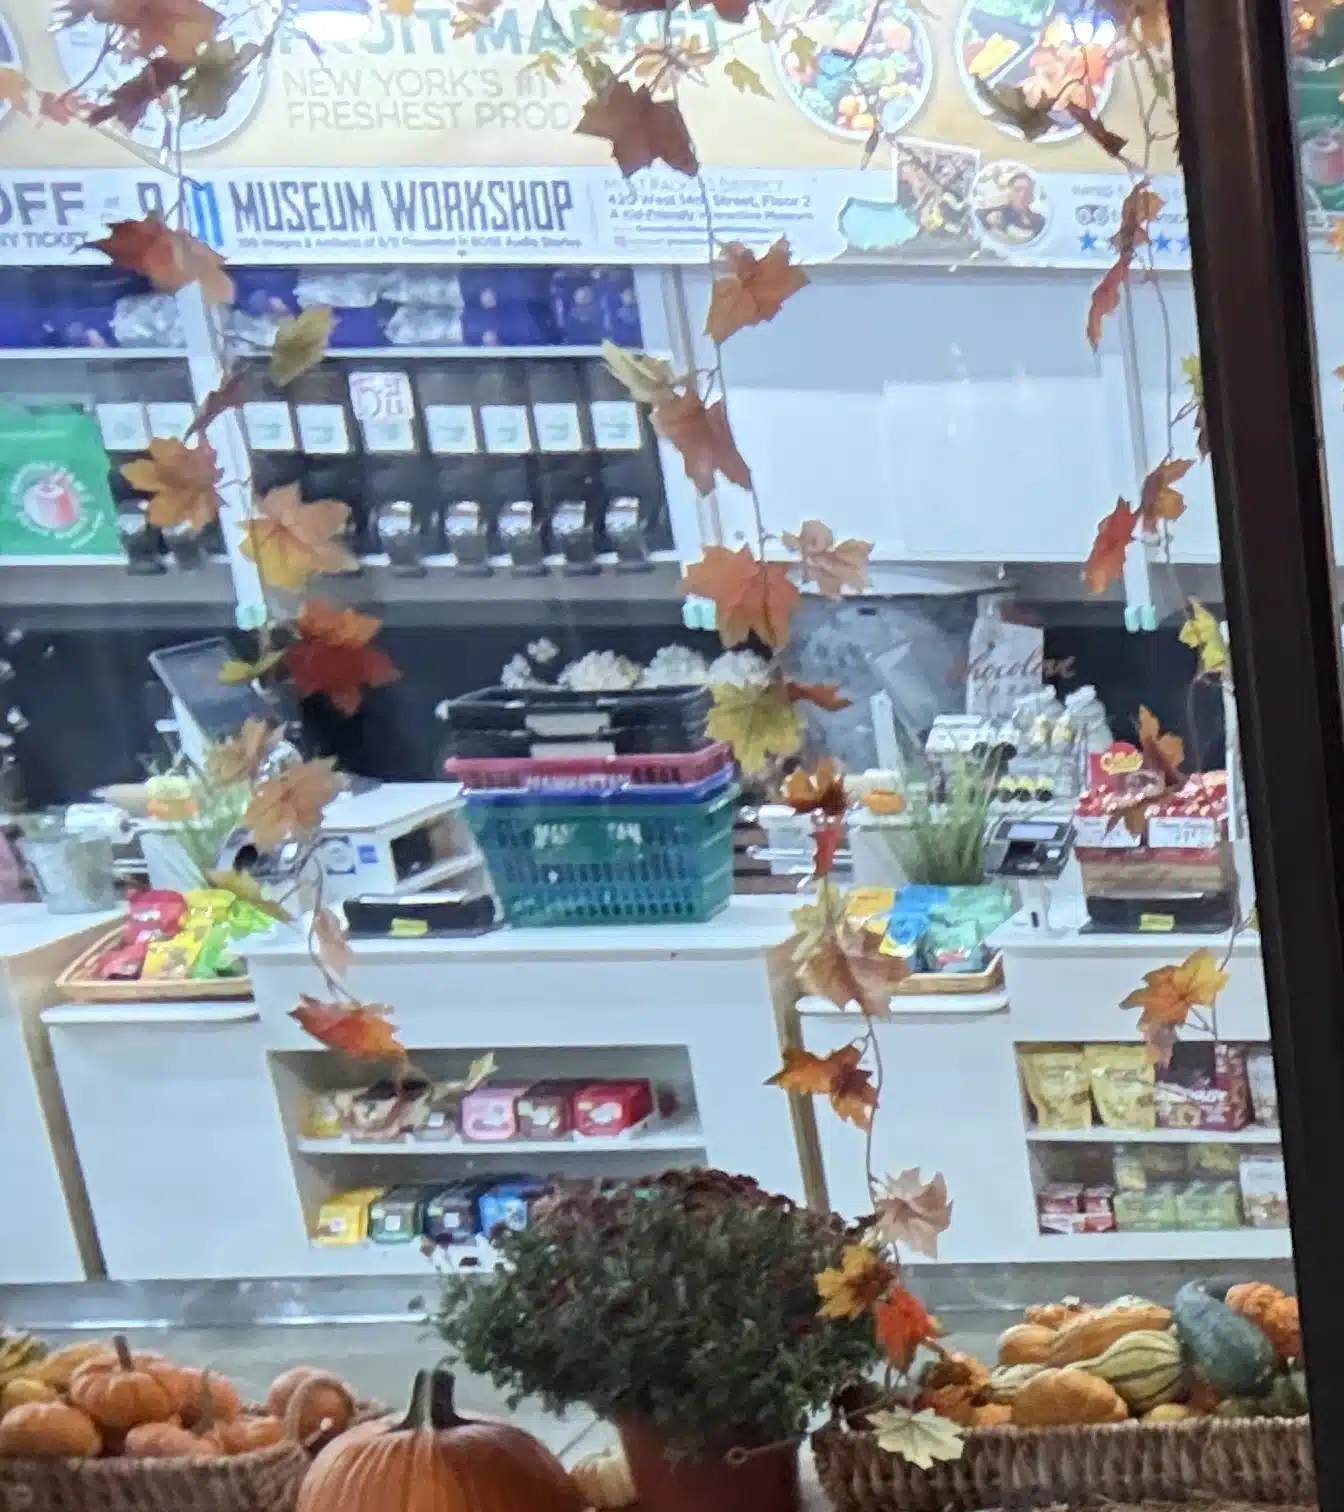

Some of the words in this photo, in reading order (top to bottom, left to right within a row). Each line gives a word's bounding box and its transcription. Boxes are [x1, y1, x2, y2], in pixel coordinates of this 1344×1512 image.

[284, 68, 361, 97] NEW
[371, 68, 504, 97] YORK'S
[287, 101, 464, 131] FRESHEST
[228, 179, 377, 233] MUSEUM
[379, 179, 575, 232] WORKSHOP
